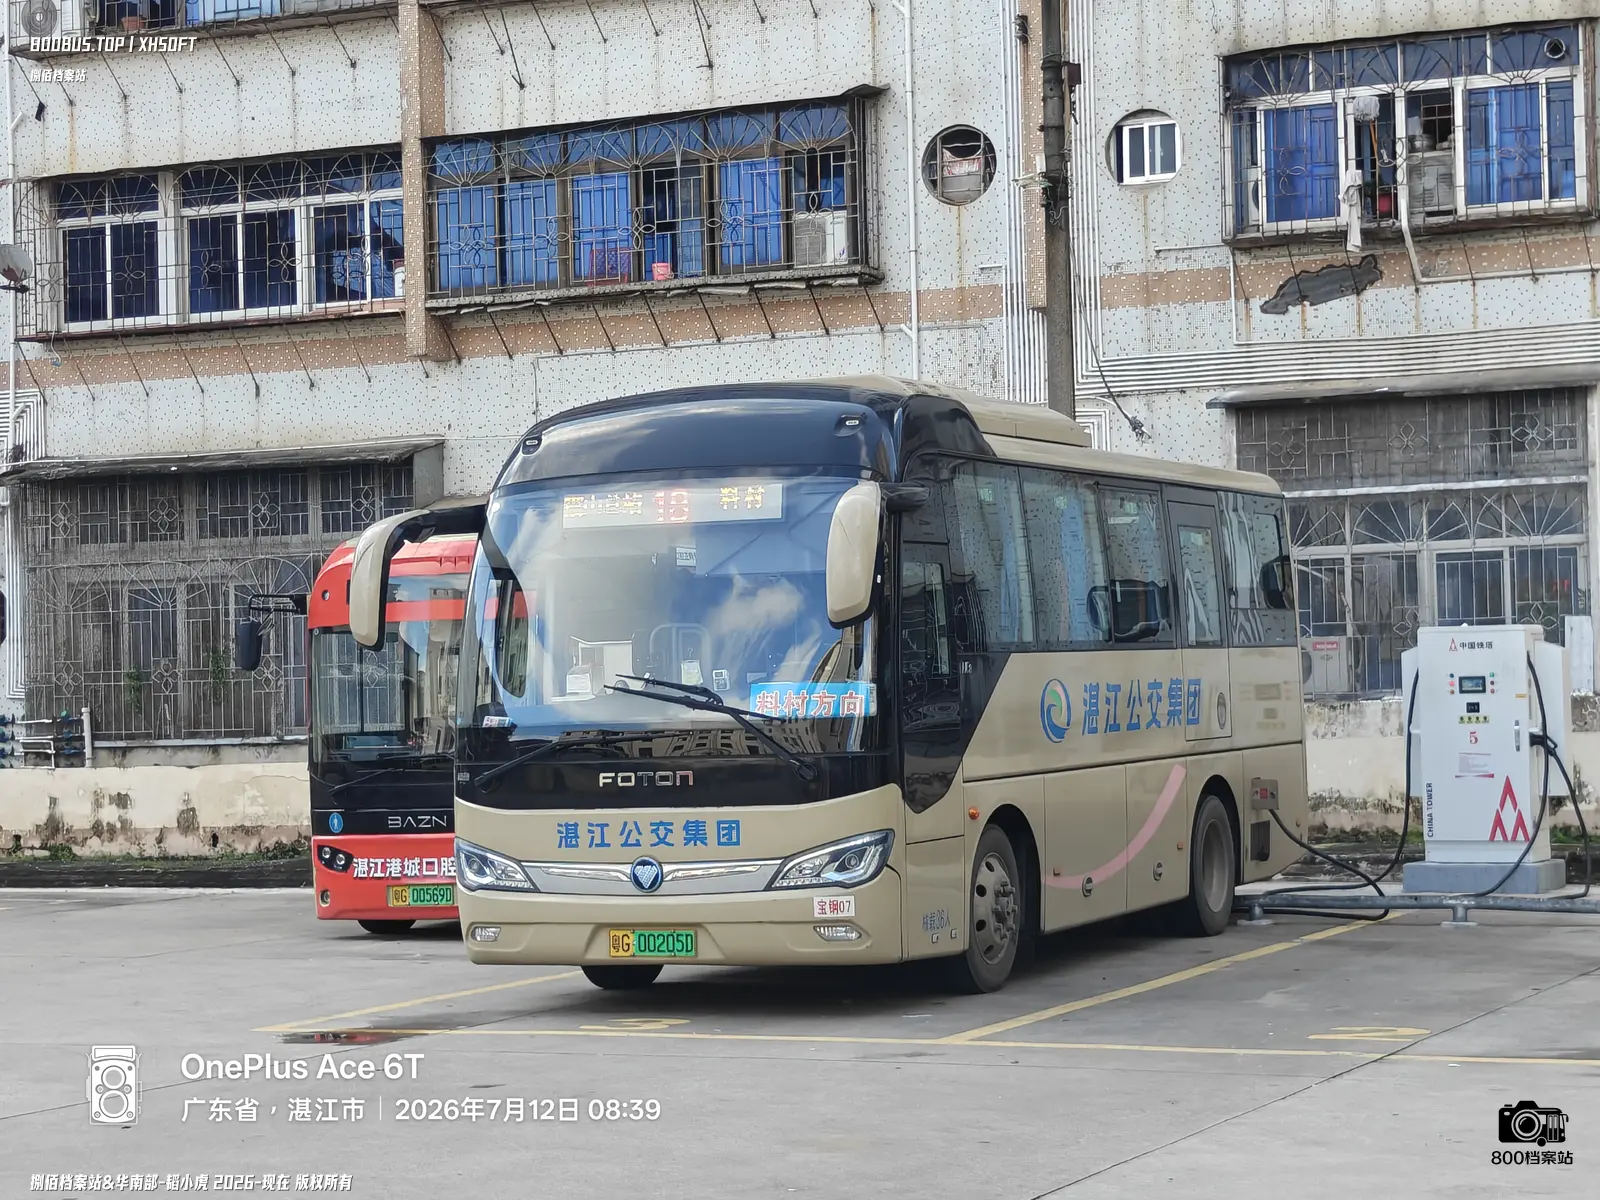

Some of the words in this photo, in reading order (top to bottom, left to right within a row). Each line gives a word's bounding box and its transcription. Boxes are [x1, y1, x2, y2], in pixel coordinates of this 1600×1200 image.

[755, 690, 865, 717] 料村方向
[1081, 677, 1202, 737] 湛江公交集团
[1469, 731, 1479, 744] 5
[599, 770, 694, 787] FOTON
[1425, 782, 1433, 811] TOWER
[557, 820, 741, 848] 湛江公交集团
[352, 856, 456, 878] 湛江港城口腔
[817, 899, 851, 915] 宝钢07
